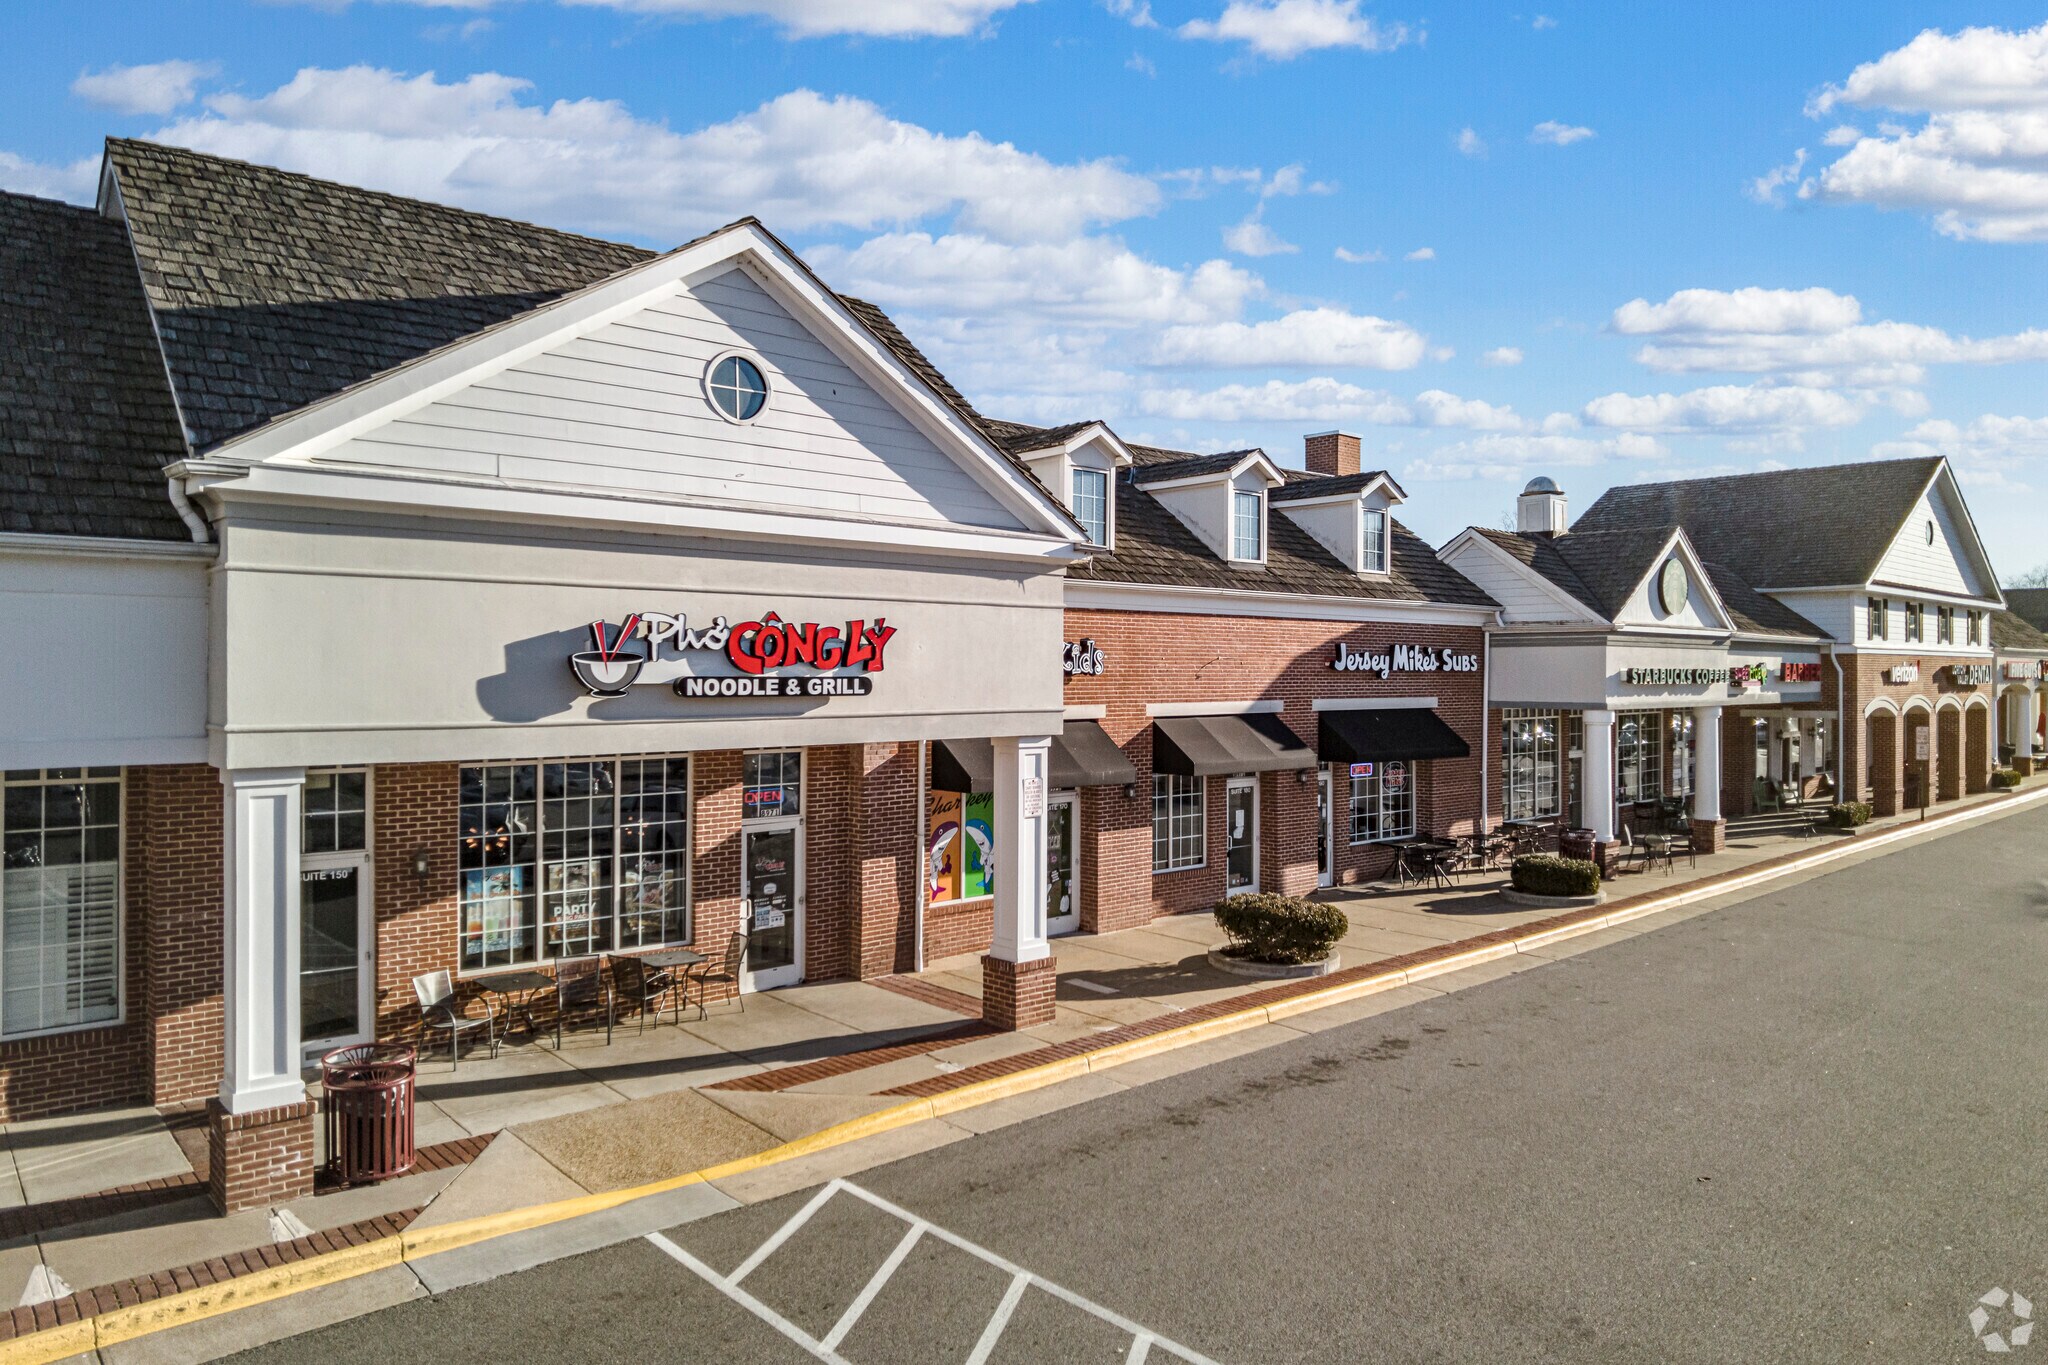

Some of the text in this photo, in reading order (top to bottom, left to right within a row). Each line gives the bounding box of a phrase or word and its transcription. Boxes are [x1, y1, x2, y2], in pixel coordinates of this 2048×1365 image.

[1334, 643, 1390, 680] Jersey
[1393, 644, 1439, 672] Mike's
[1631, 668, 1730, 684] STARBUCKS COFFEE
[686, 678, 865, 696] NOODLE & GRILL
[1351, 765, 1371, 775] OPEN
[745, 791, 782, 803] OPEN
[300, 870, 349, 882] UITE 150
[553, 902, 597, 918] PARTY
